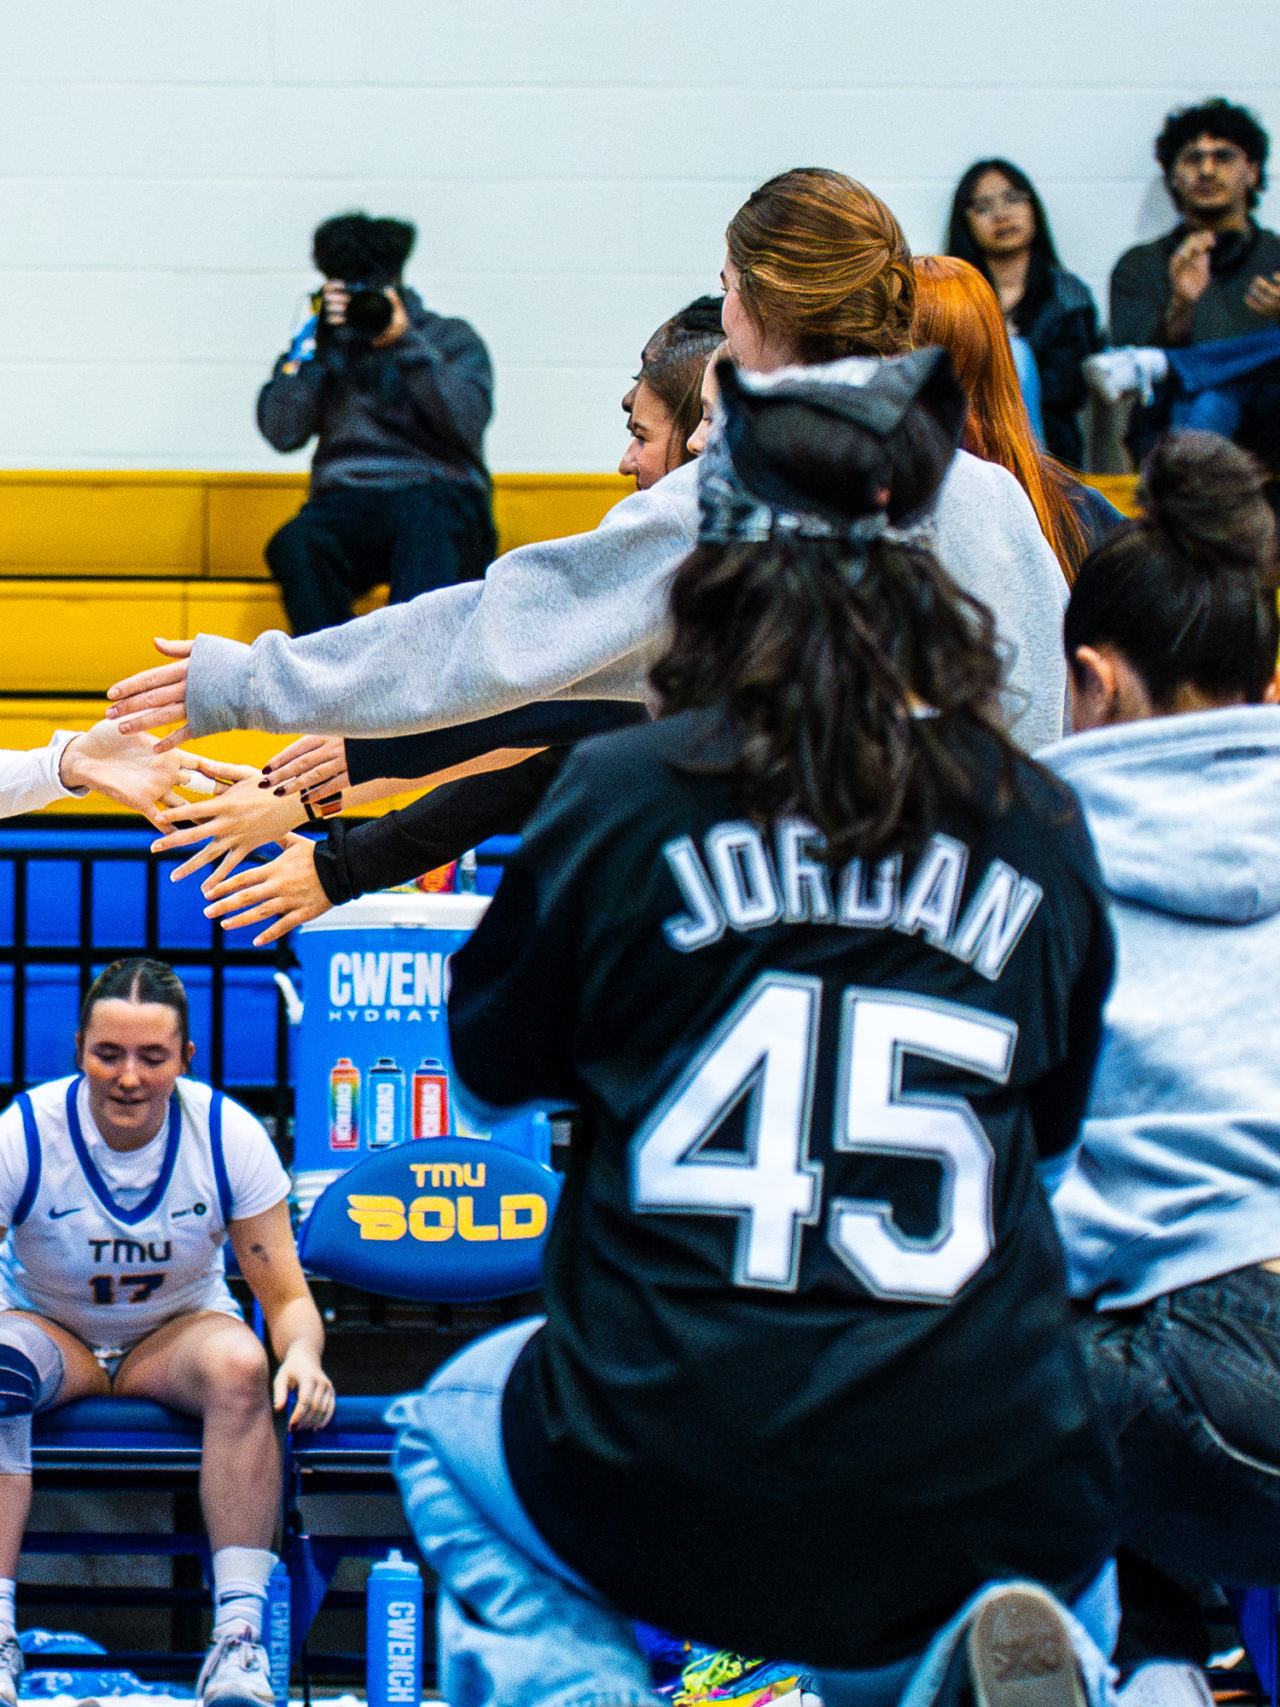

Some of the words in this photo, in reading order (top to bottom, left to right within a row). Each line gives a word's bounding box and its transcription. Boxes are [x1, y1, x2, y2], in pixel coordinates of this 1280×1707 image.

[662, 816, 1045, 982] JORDAN
[329, 951, 452, 1007] CWEN
[627, 968, 1020, 1306] 45
[409, 1162, 487, 1188] TMU
[346, 1193, 548, 1242] BOLD
[88, 1237, 173, 1264] TMU
[88, 1271, 166, 1306] 17
[387, 1601, 416, 1702] CWENCH
